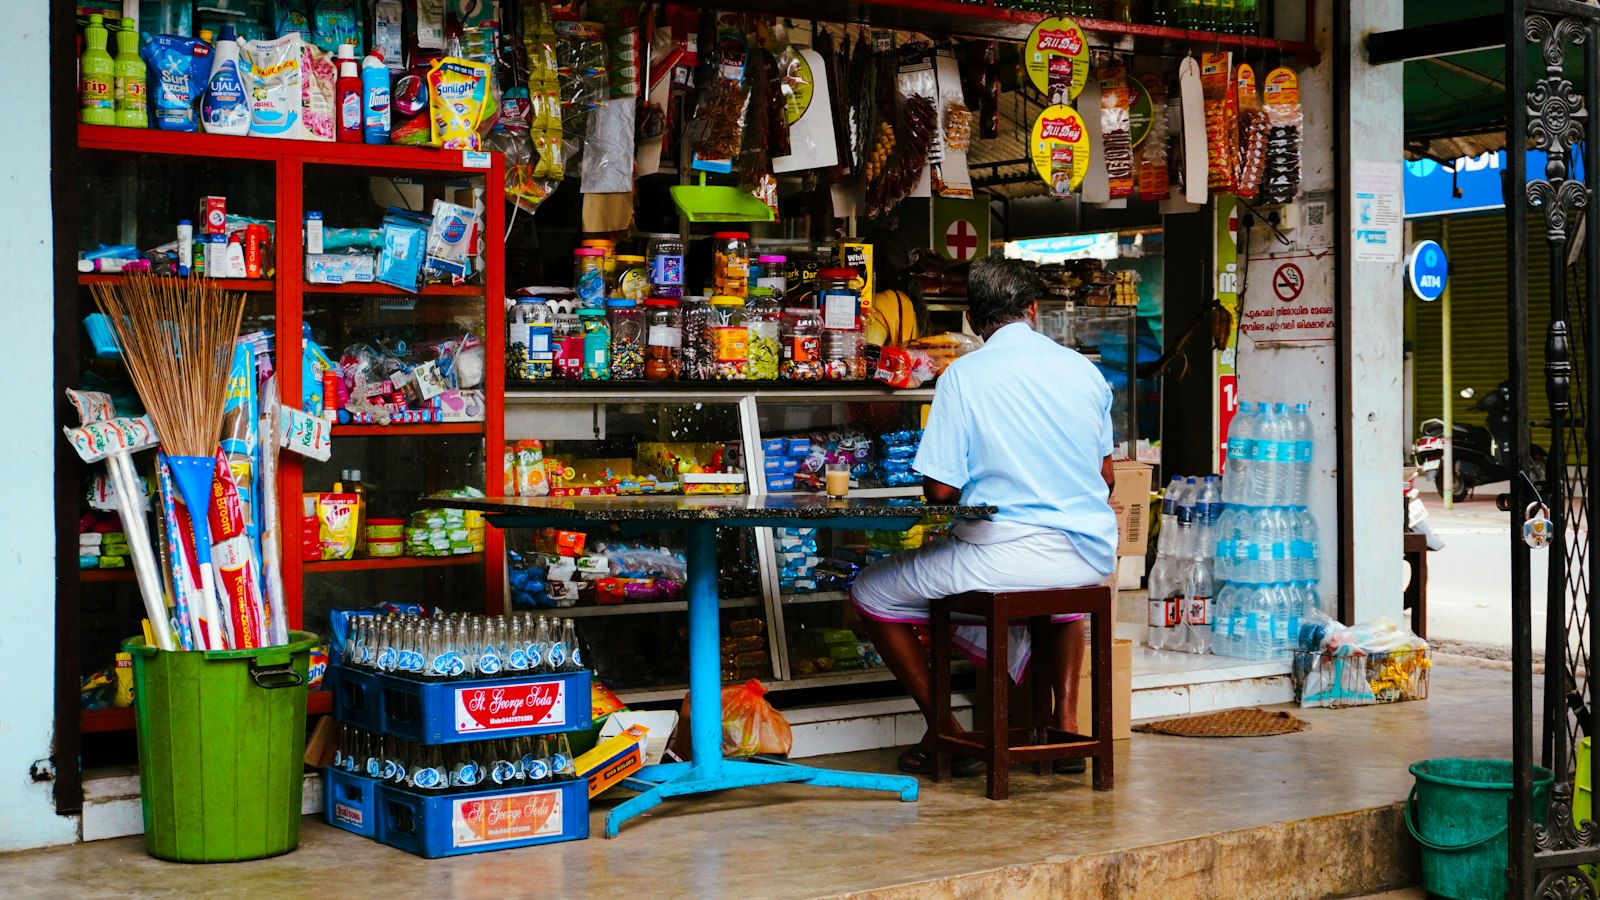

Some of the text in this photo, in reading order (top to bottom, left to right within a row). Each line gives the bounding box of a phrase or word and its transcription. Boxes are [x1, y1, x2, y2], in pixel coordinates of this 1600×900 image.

[1039, 37, 1081, 54] All Day
[161, 70, 190, 84] Surf
[256, 66, 276, 77] VALUE
[83, 80, 106, 94] Tip
[162, 82, 190, 93] excel
[211, 82, 241, 92] UJALA
[437, 80, 476, 96] Sunlight
[1042, 124, 1081, 140] All Day
[249, 235, 257, 260] Cuticura
[847, 253, 870, 263] White
[802, 270, 818, 280] Dar
[1420, 275, 1441, 288] ATM
[302, 418, 313, 447] Kerala
[518, 450, 543, 464] TANG
[217, 497, 232, 535] Broom
[325, 505, 350, 528] Vim
[227, 544, 238, 565] Kerala
[235, 575, 246, 613] Kerala
[489, 688, 525, 716] George
[526, 686, 552, 707] Soda
[606, 757, 635, 778] SOFTER BAR
[488, 799, 522, 827] George
[524, 796, 550, 816] Soda
